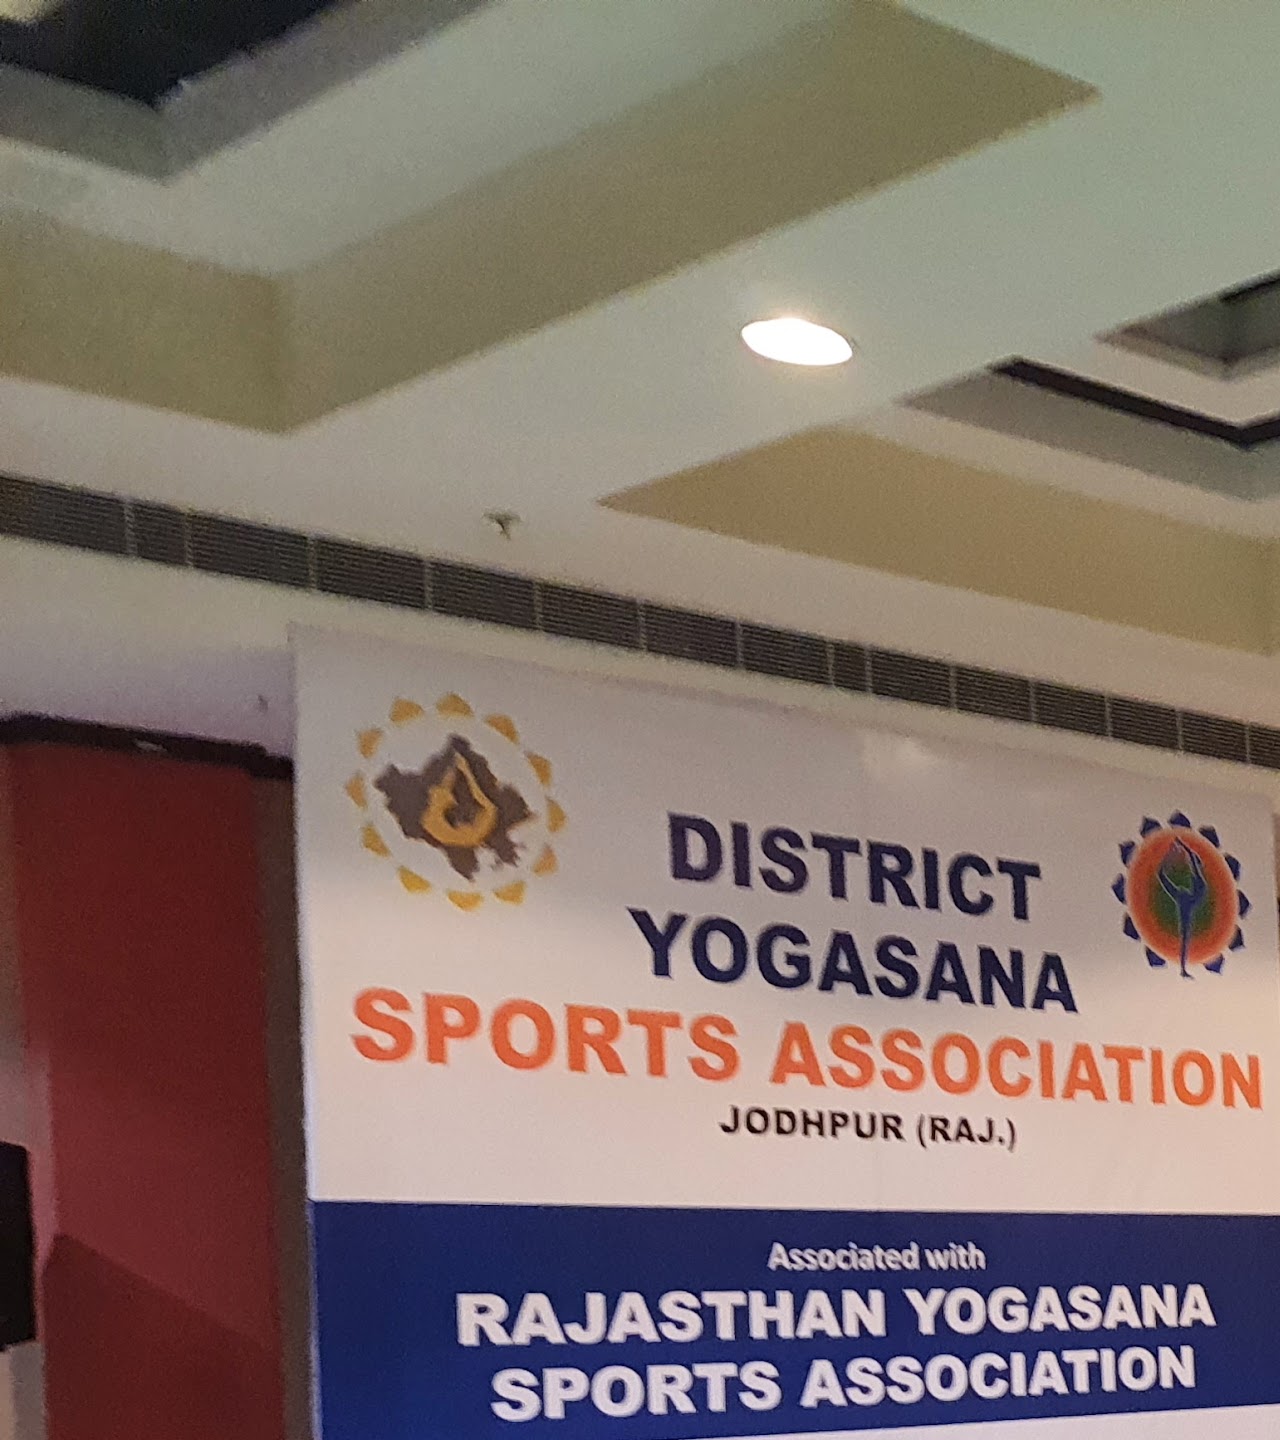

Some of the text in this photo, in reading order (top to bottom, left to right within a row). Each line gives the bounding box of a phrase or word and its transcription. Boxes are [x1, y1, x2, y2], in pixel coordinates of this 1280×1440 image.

[665, 812, 1041, 921] DISTRICT
[627, 906, 1078, 1013] YOGASANA
[355, 989, 1262, 1109] SPORTS ASSOCIATION
[719, 1105, 1018, 1151] JODHPUR (RAJ.)
[768, 1242, 985, 1270] Associated with
[457, 1283, 1217, 1346] RAJASTHAN YOGASANA
[492, 1345, 1197, 1421] SPORTS ASSOCIATION
